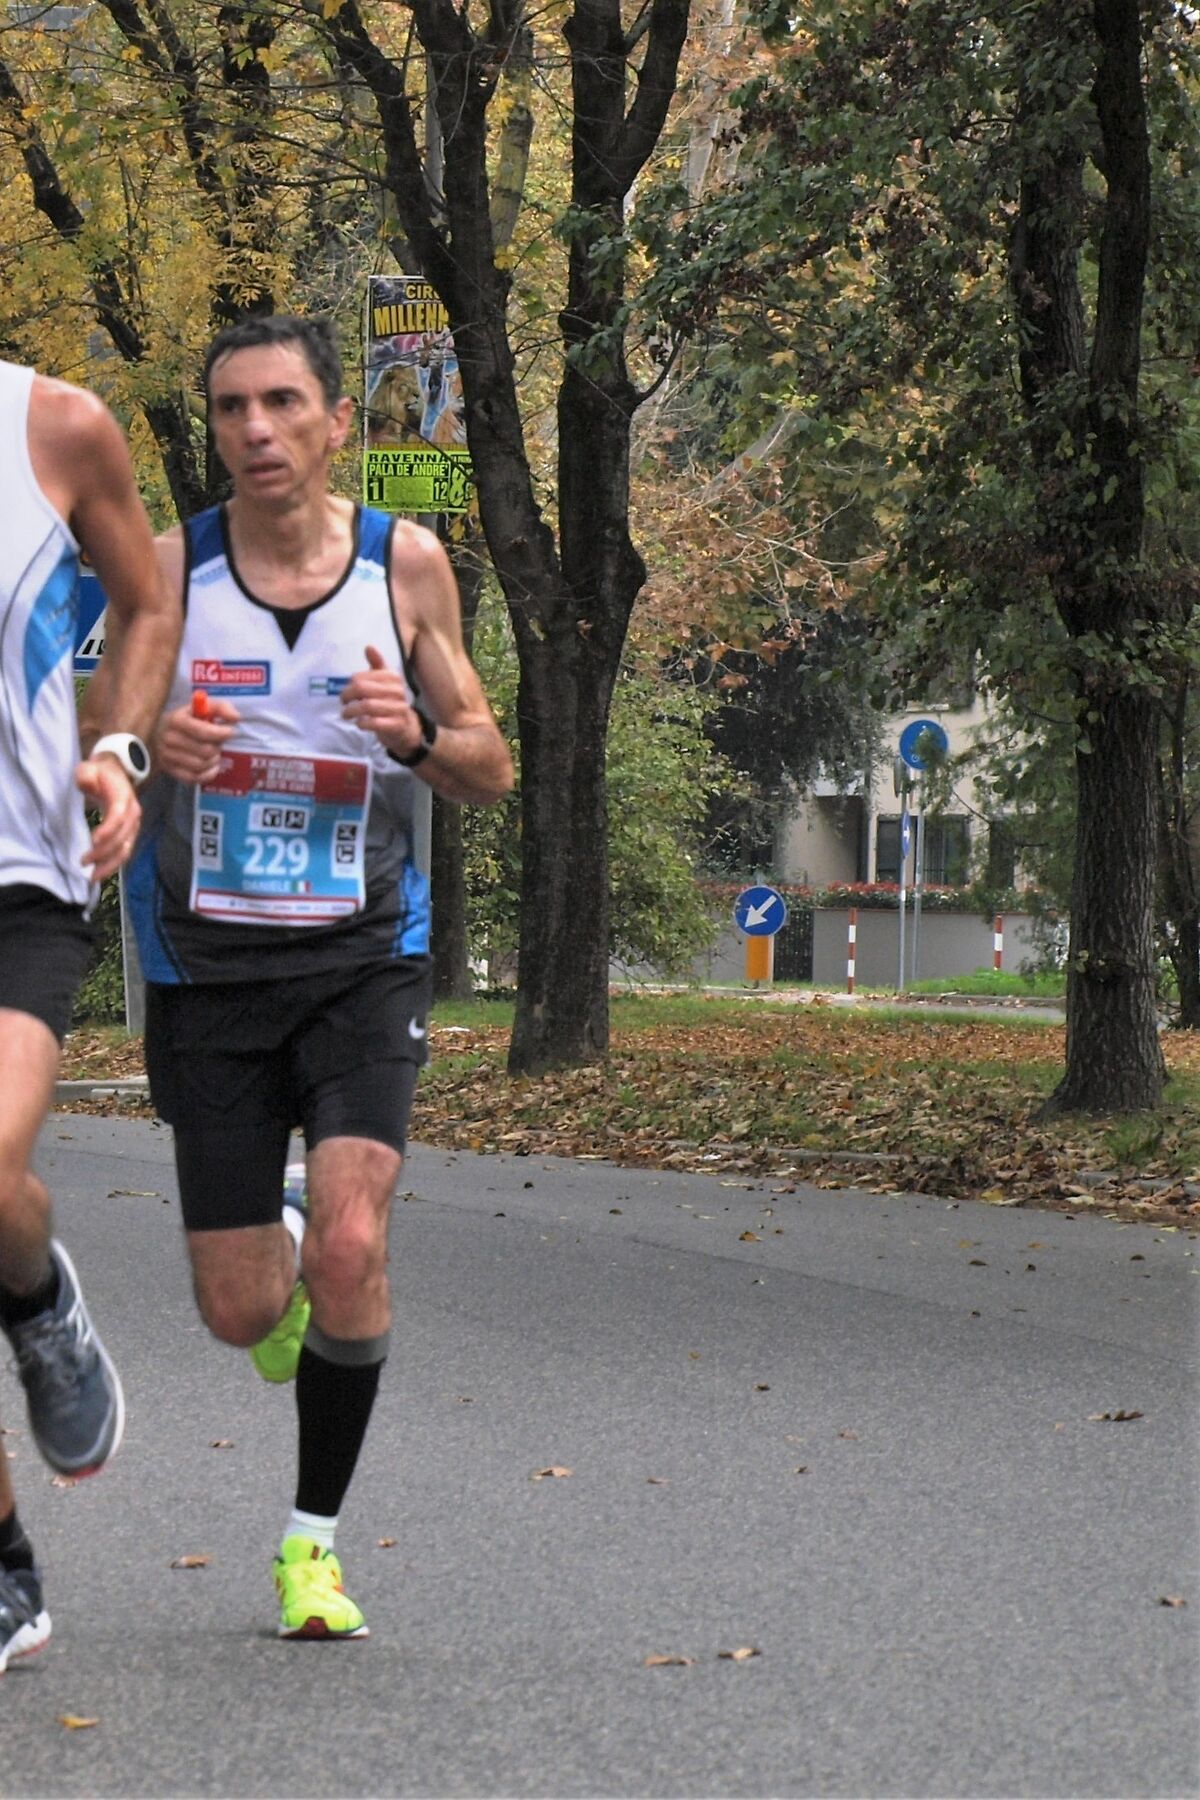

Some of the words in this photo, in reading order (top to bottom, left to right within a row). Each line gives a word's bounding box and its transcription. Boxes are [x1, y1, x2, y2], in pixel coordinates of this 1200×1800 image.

[406, 284, 441, 299] CIR
[369, 454, 449, 463] RAVENNA
[369, 464, 395, 476] PALA
[397, 464, 410, 476] DE
[369, 481, 380, 500] 1
[434, 481, 448, 500] 12
[243, 835, 310, 877] 229
